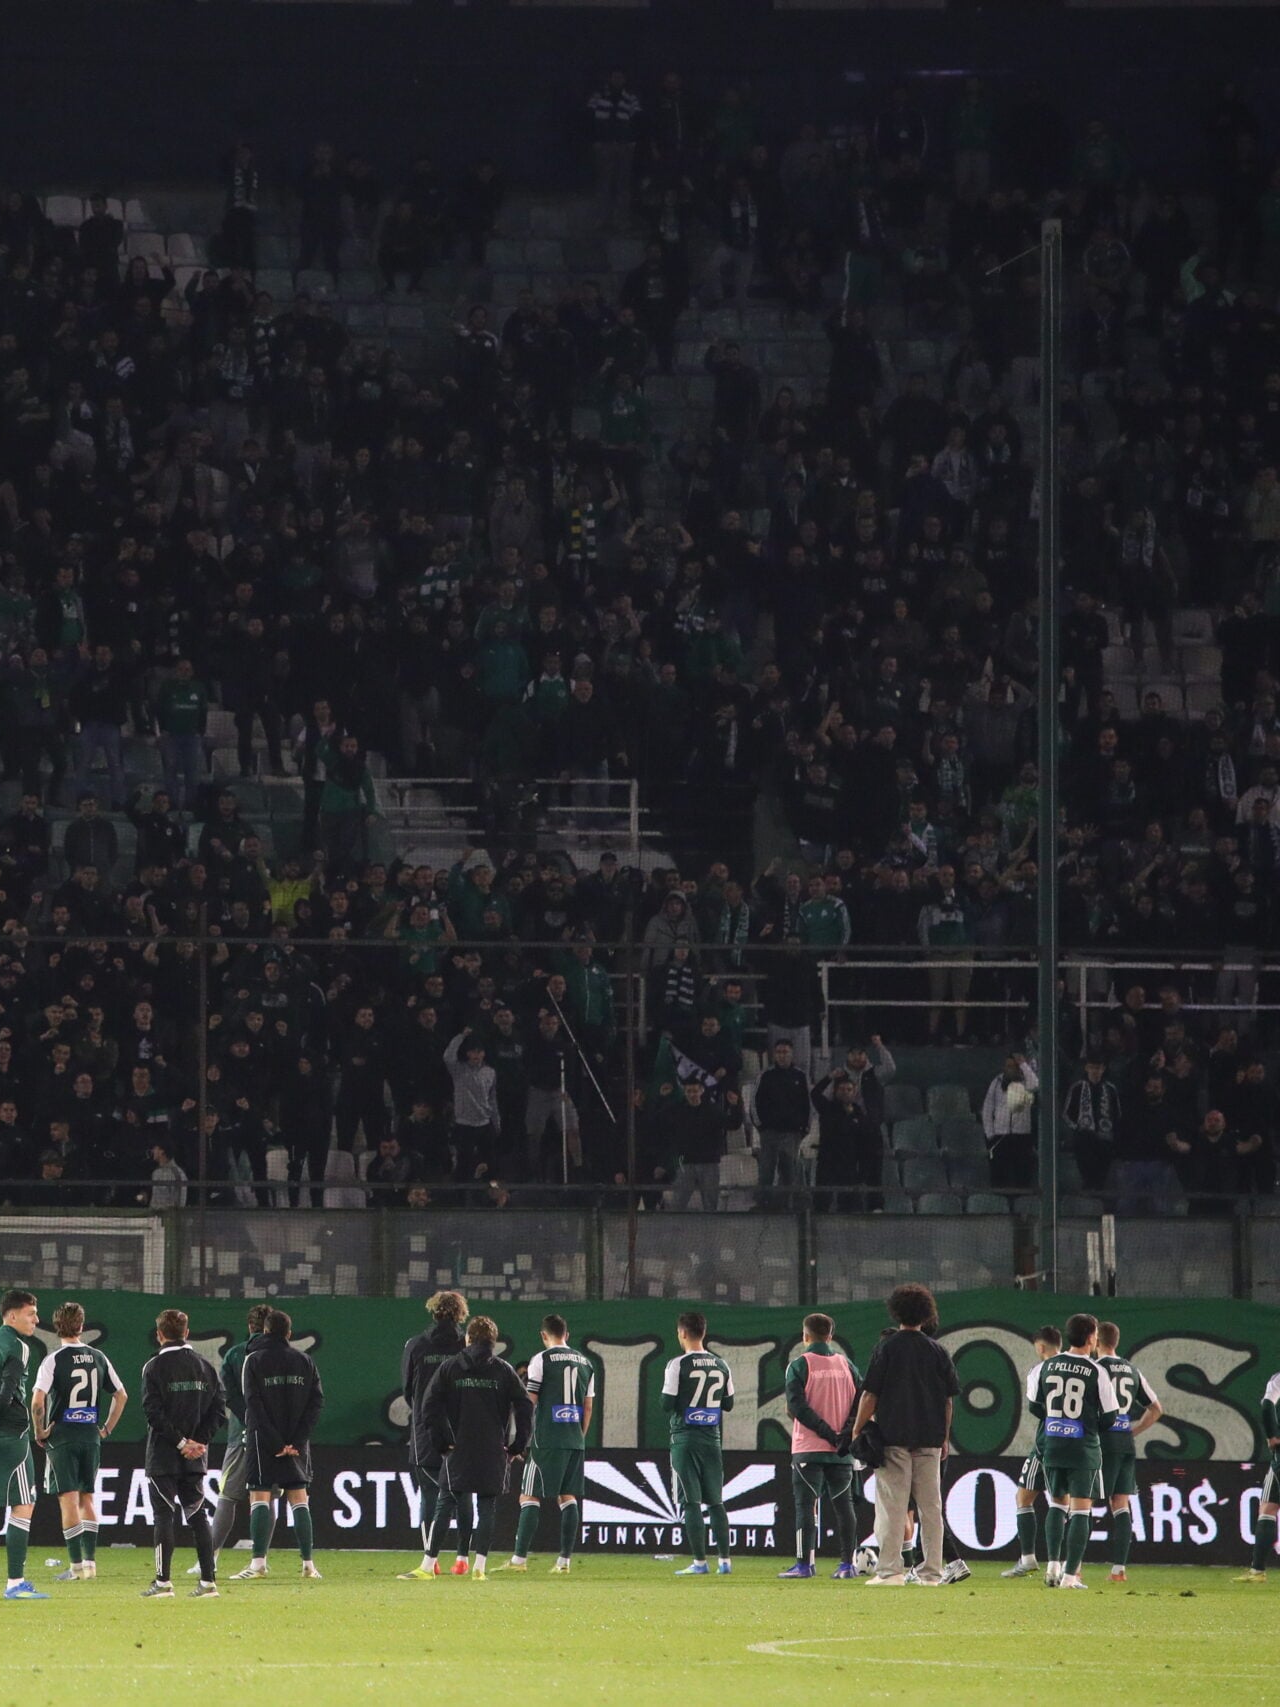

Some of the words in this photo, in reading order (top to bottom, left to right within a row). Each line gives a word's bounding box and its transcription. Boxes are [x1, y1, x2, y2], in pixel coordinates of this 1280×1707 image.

[69, 1368, 98, 1409] 21
[563, 1365, 578, 1405] 11
[689, 1369, 724, 1408] 72
[1055, 1363, 1092, 1377] PELLISTRI
[1045, 1375, 1086, 1419] 28
